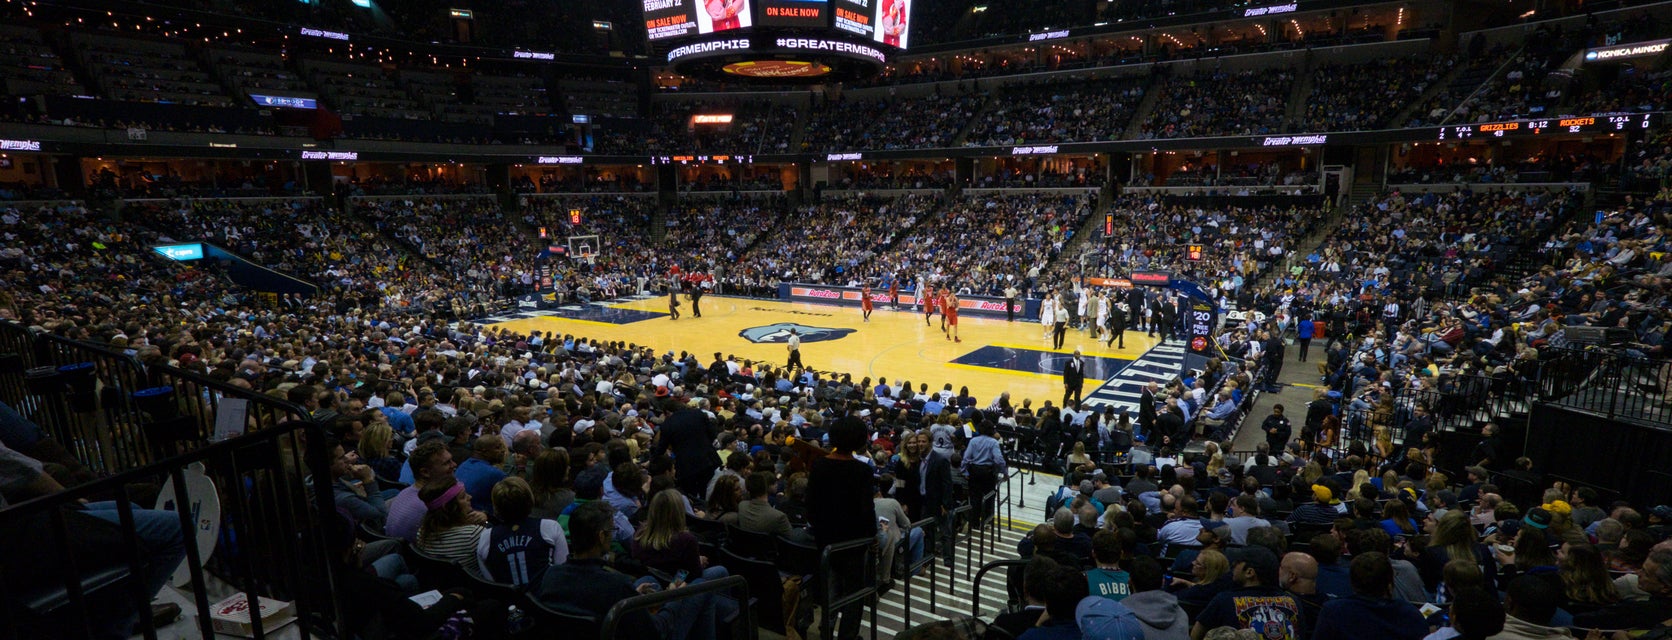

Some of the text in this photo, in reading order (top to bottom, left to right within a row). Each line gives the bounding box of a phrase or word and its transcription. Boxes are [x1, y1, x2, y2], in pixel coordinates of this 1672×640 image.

[767, 7, 819, 17] ON SALE NOW
[836, 8, 844, 17] ON
[844, 10, 856, 21] SALE
[646, 14, 687, 28] ON SALE NOW
[1597, 43, 1670, 59] KONICA MINOLT
[1480, 122, 1518, 132] GRIZZLIES
[1528, 121, 1548, 129] 8:12
[1559, 118, 1595, 127] ROCKETS
[1642, 120, 1649, 128] 0
[0, 139, 41, 150] Memphis
[808, 289, 840, 299] AutoZone
[980, 301, 1021, 312] AutoZne
[1193, 311, 1210, 321] $20
[498, 535, 533, 552] CONLEY
[507, 551, 529, 586] 11
